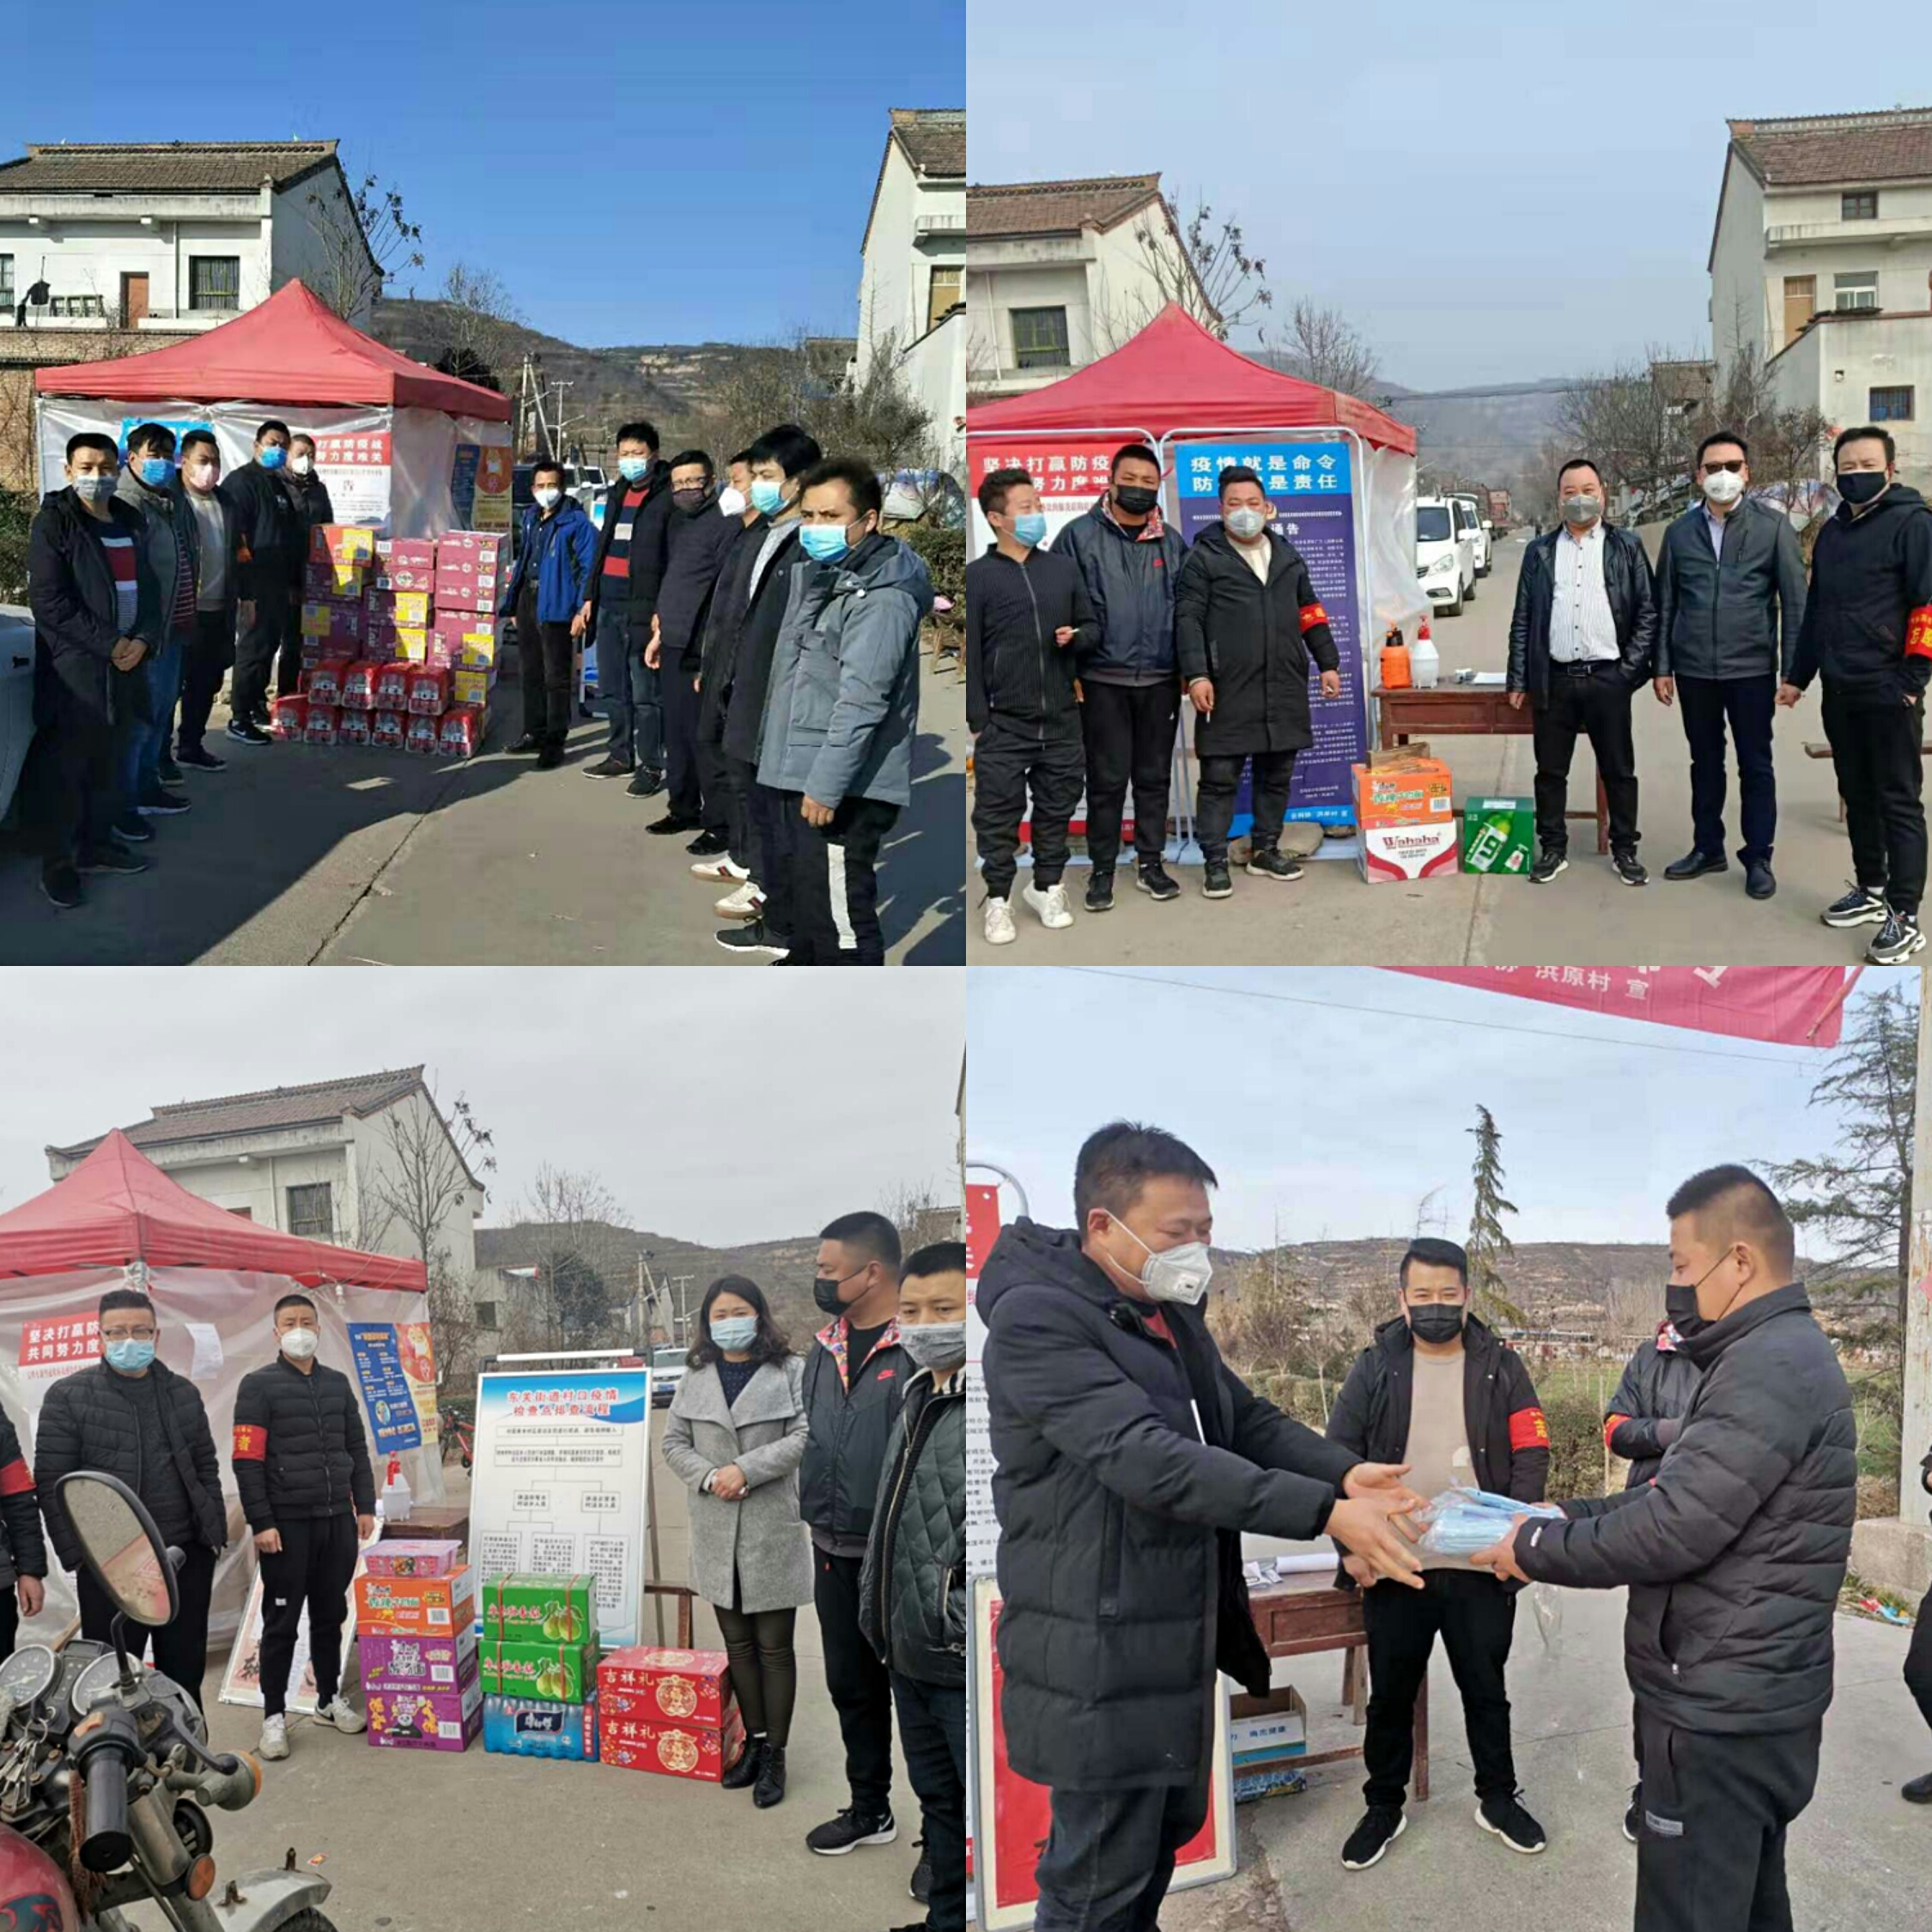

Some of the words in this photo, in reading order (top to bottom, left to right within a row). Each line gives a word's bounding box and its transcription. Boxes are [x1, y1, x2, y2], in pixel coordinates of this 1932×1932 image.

[1191, 453, 1336, 472] 疫情就是命令
[1193, 474, 1338, 492] 防是责任
[1625, 979, 1649, 1000] 宣
[605, 1668, 654, 1686] 吉祥礼
[605, 1719, 656, 1740] 吉祥礼
